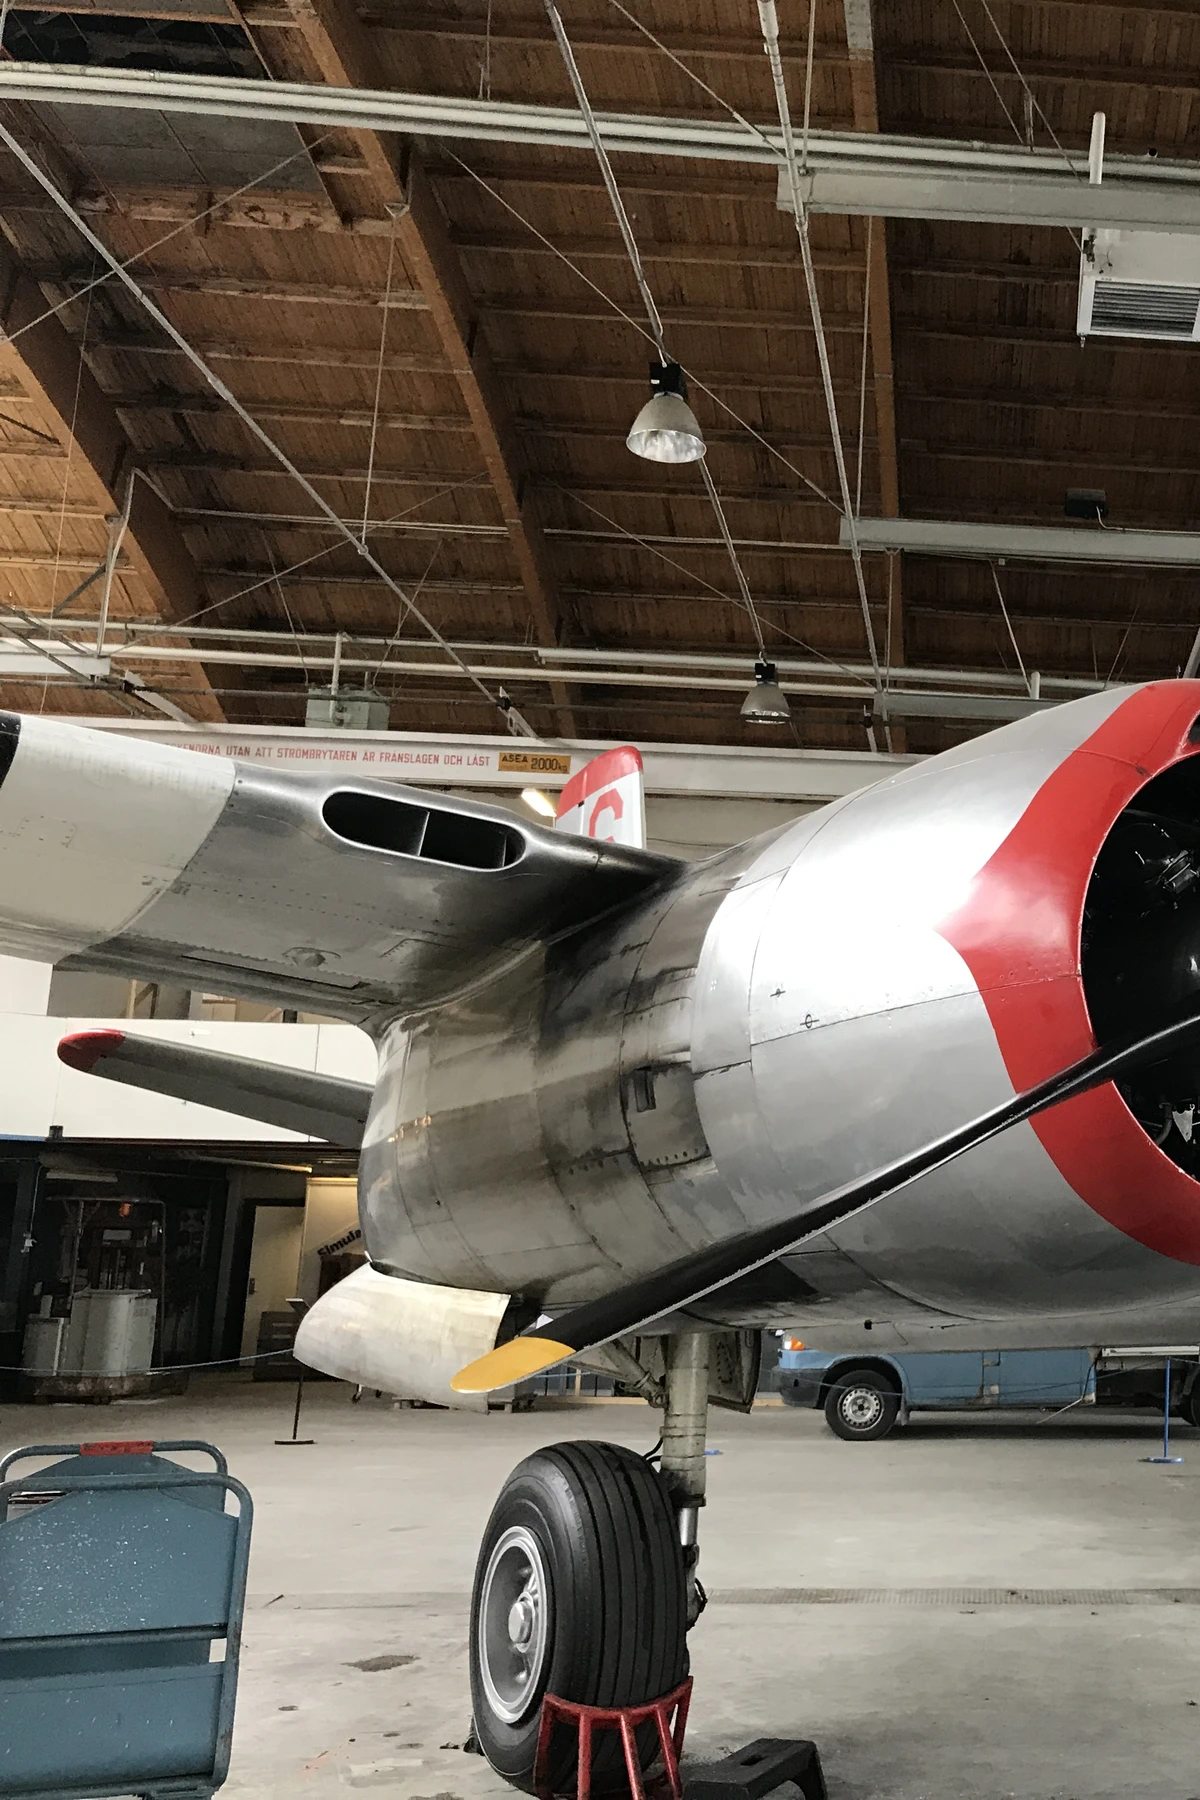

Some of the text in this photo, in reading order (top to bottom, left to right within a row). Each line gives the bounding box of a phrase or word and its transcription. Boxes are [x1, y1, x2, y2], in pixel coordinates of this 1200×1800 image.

[226, 745, 250, 757] UTAN
[255, 747, 273, 757] ATT
[277, 747, 358, 761] STRÖMBRYTAREN
[443, 755, 463, 765] OCH
[466, 754, 490, 767] LÅST
[501, 753, 528, 763] ASEA
